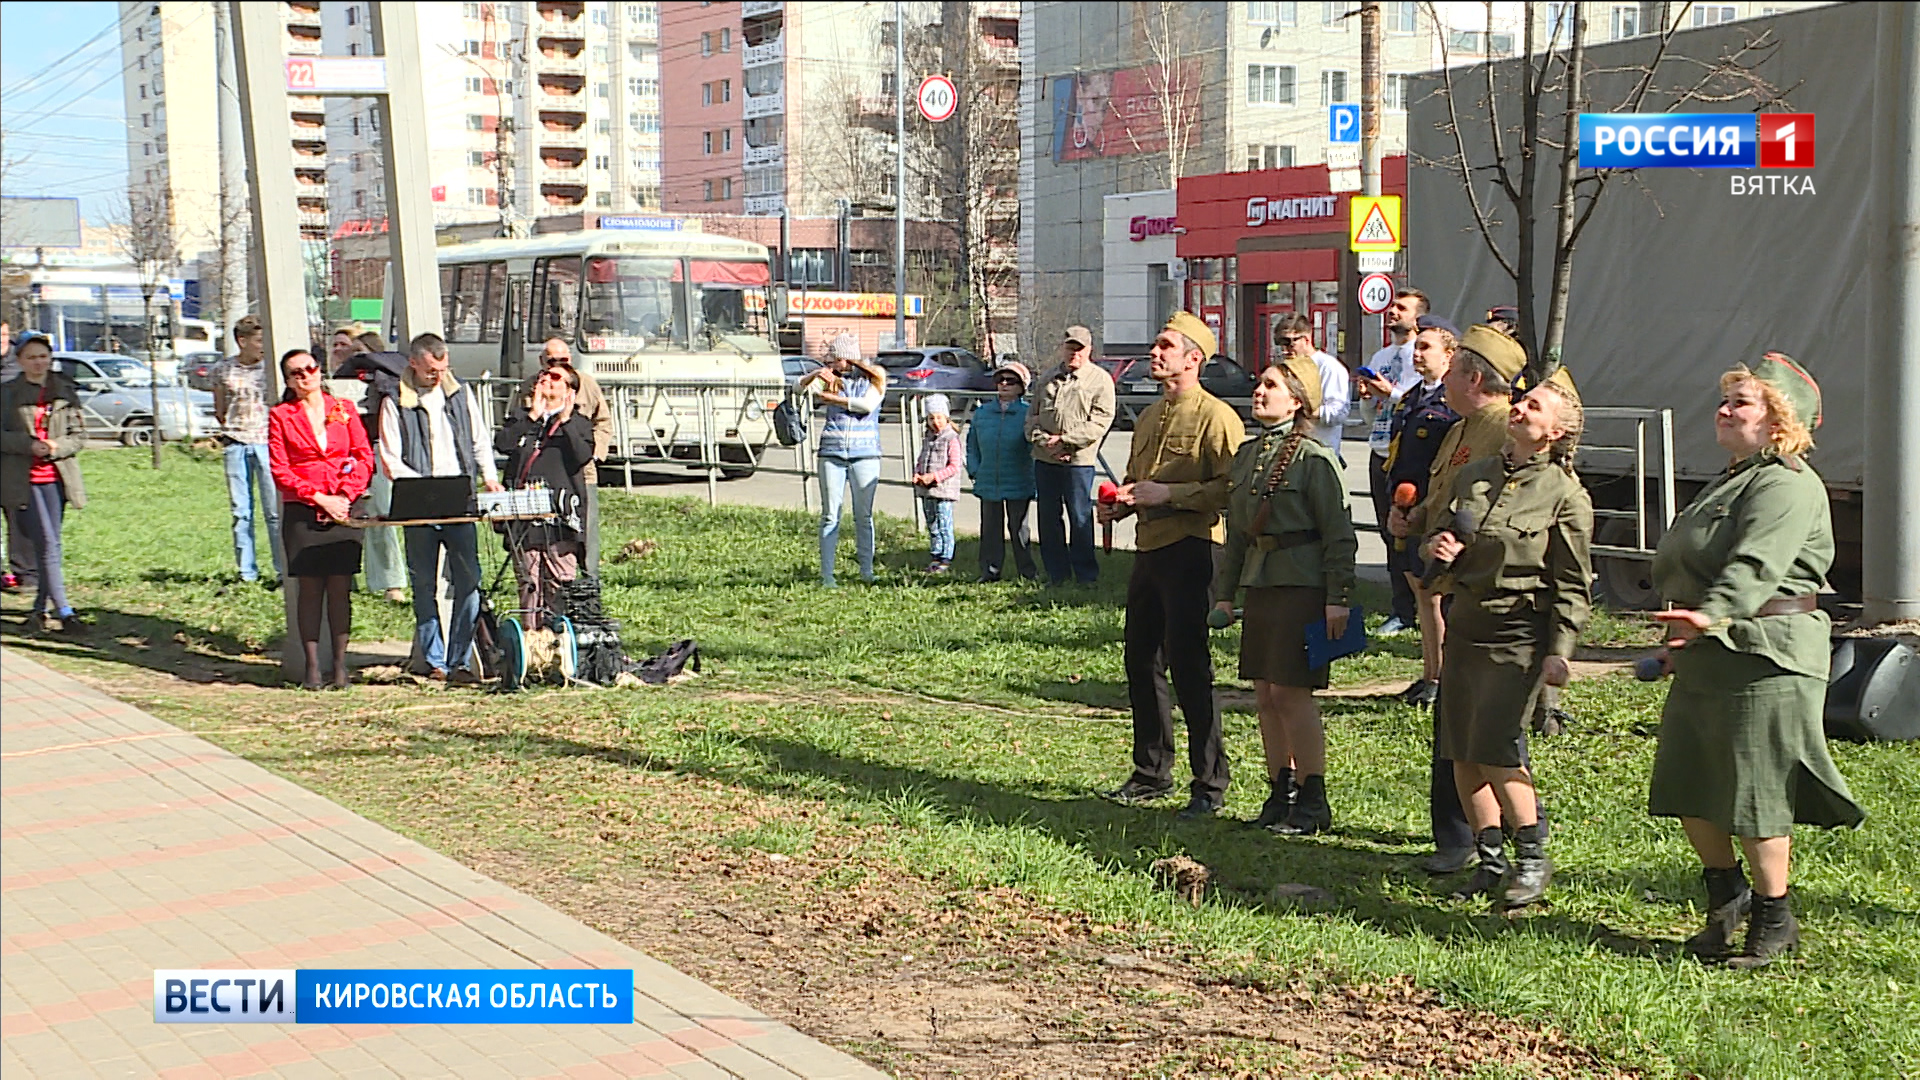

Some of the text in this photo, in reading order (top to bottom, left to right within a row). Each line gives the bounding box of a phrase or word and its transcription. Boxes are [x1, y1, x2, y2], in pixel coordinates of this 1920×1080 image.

[290, 64, 313, 86] 22
[925, 89, 948, 106] 40
[1335, 109, 1353, 140] P
[1268, 196, 1338, 220] МАГНИТ
[1366, 287, 1387, 302] 40
